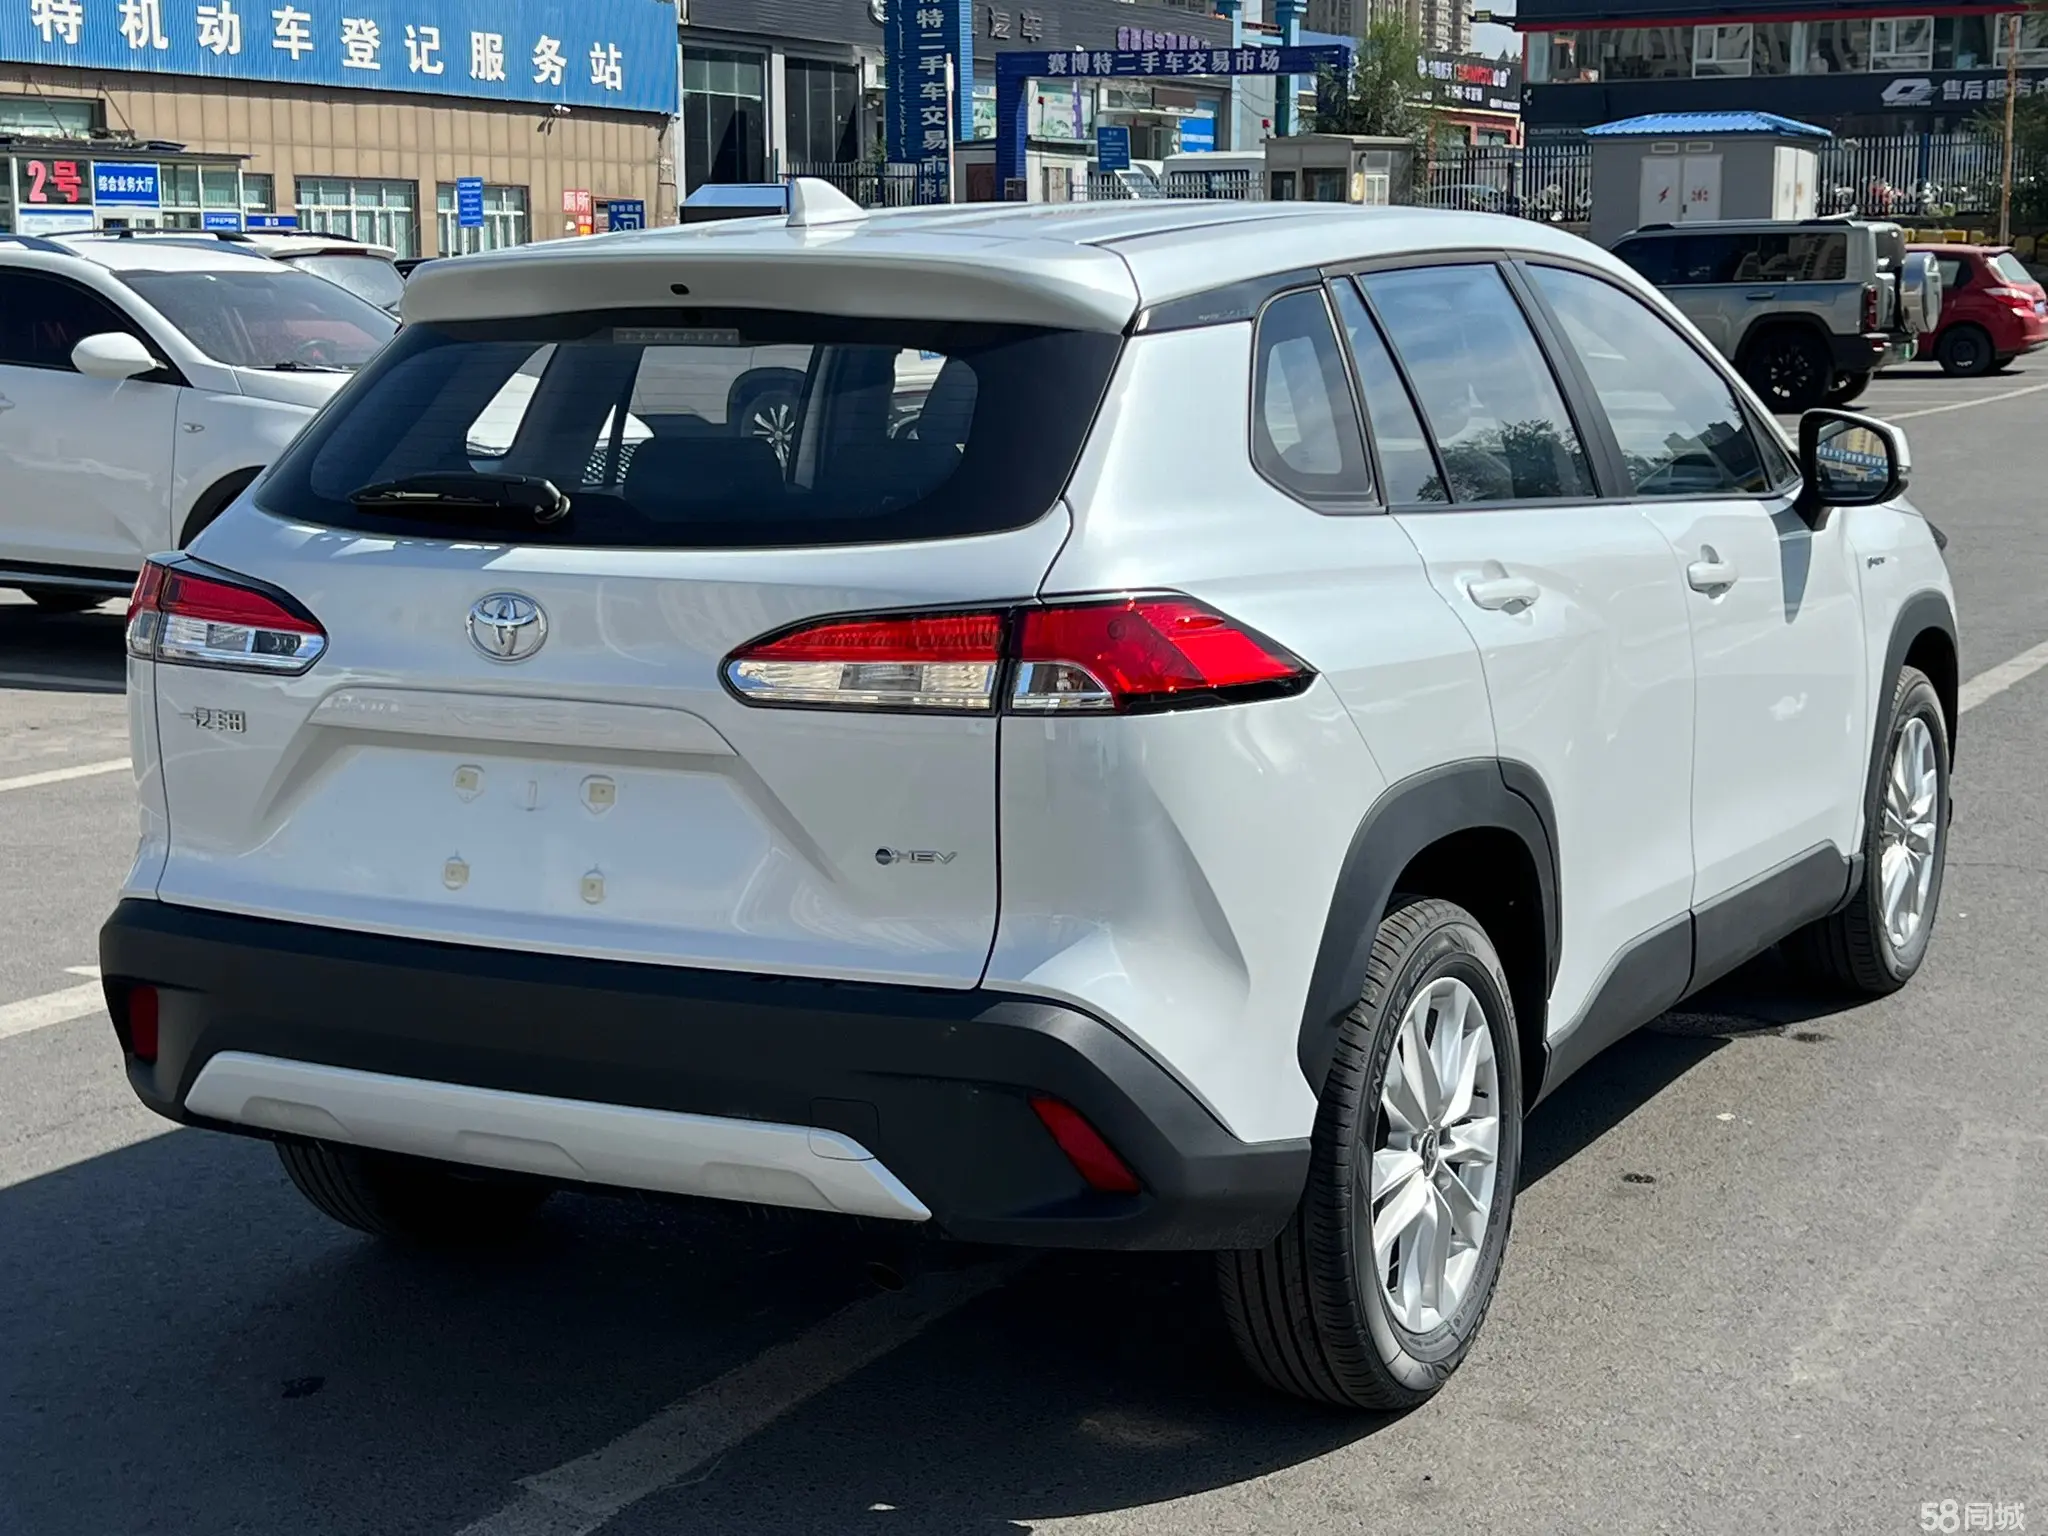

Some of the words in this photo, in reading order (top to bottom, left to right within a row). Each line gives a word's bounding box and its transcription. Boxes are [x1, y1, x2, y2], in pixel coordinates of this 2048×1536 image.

[31, 0, 623, 91] 特机动车登记服务站
[1047, 50, 1280, 75] 赛博特二手车交易市场
[916, 0, 948, 198] 特二手车交易市场
[26, 159, 82, 203] 2号
[98, 175, 153, 193] 综合业务大厅
[563, 191, 590, 212] 厕所
